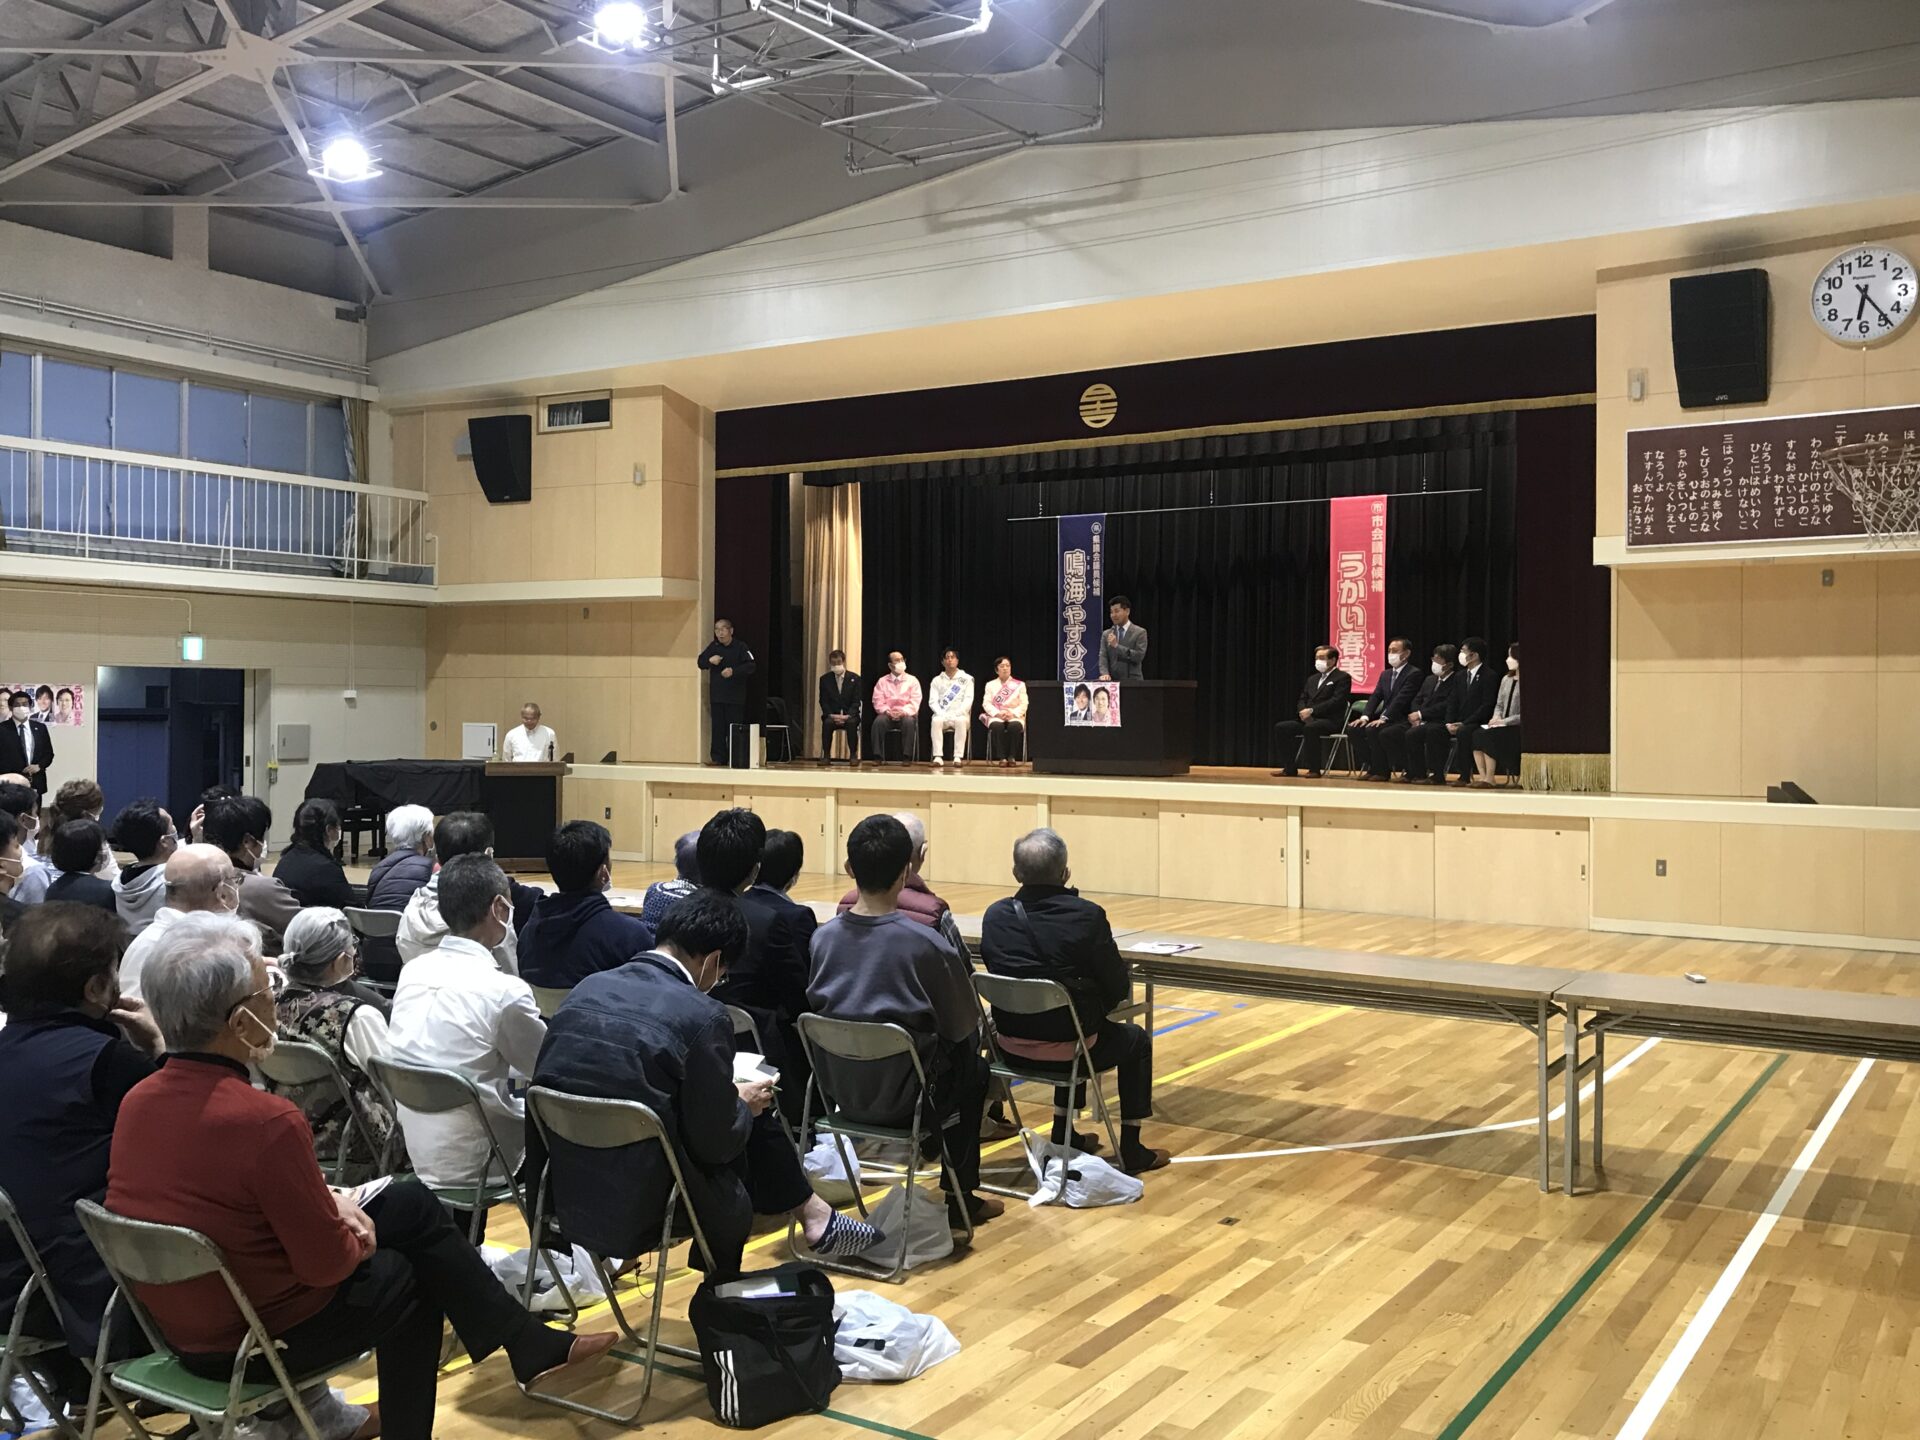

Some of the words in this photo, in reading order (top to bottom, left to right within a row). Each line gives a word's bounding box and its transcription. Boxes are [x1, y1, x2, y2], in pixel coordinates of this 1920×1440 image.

[1824, 276, 1842, 290] 10
[1837, 262, 1852, 275] 11
[1855, 254, 1873, 268] 12
[1880, 258, 1887, 270] 1
[1892, 267, 1903, 280] 2
[1821, 293, 1832, 306] 9
[1890, 301, 1901, 313] 4
[1897, 283, 1908, 296] 3
[1827, 308, 1838, 321] 8
[1841, 318, 1853, 331] 7
[1858, 321, 1870, 334] 6
[1878, 313, 1888, 327] 5
[1655, 450, 1665, 492] なろうよ
[1677, 449, 1688, 523] ちからをいつも
[1750, 443, 1761, 529] ひとにはめいわく
[1762, 442, 1772, 485] なろうよ
[1786, 440, 1797, 516] すなおさいつも
[1810, 438, 1822, 525] わかたけのような
[1644, 451, 1654, 535] すすんでかんがえ
[1666, 482, 1676, 534] たくわえて
[1688, 480, 1699, 532] ひよしのこ
[1700, 446, 1711, 532] とびうおのような
[1712, 478, 1723, 531] うみをゆく
[1738, 477, 1749, 530] かけないこ
[1774, 474, 1785, 527] わすれずに
[1798, 473, 1809, 526] ひよしのこ
[1064, 549, 1087, 681] 鳴海やすひろ
[1337, 551, 1367, 685] うかい春美
